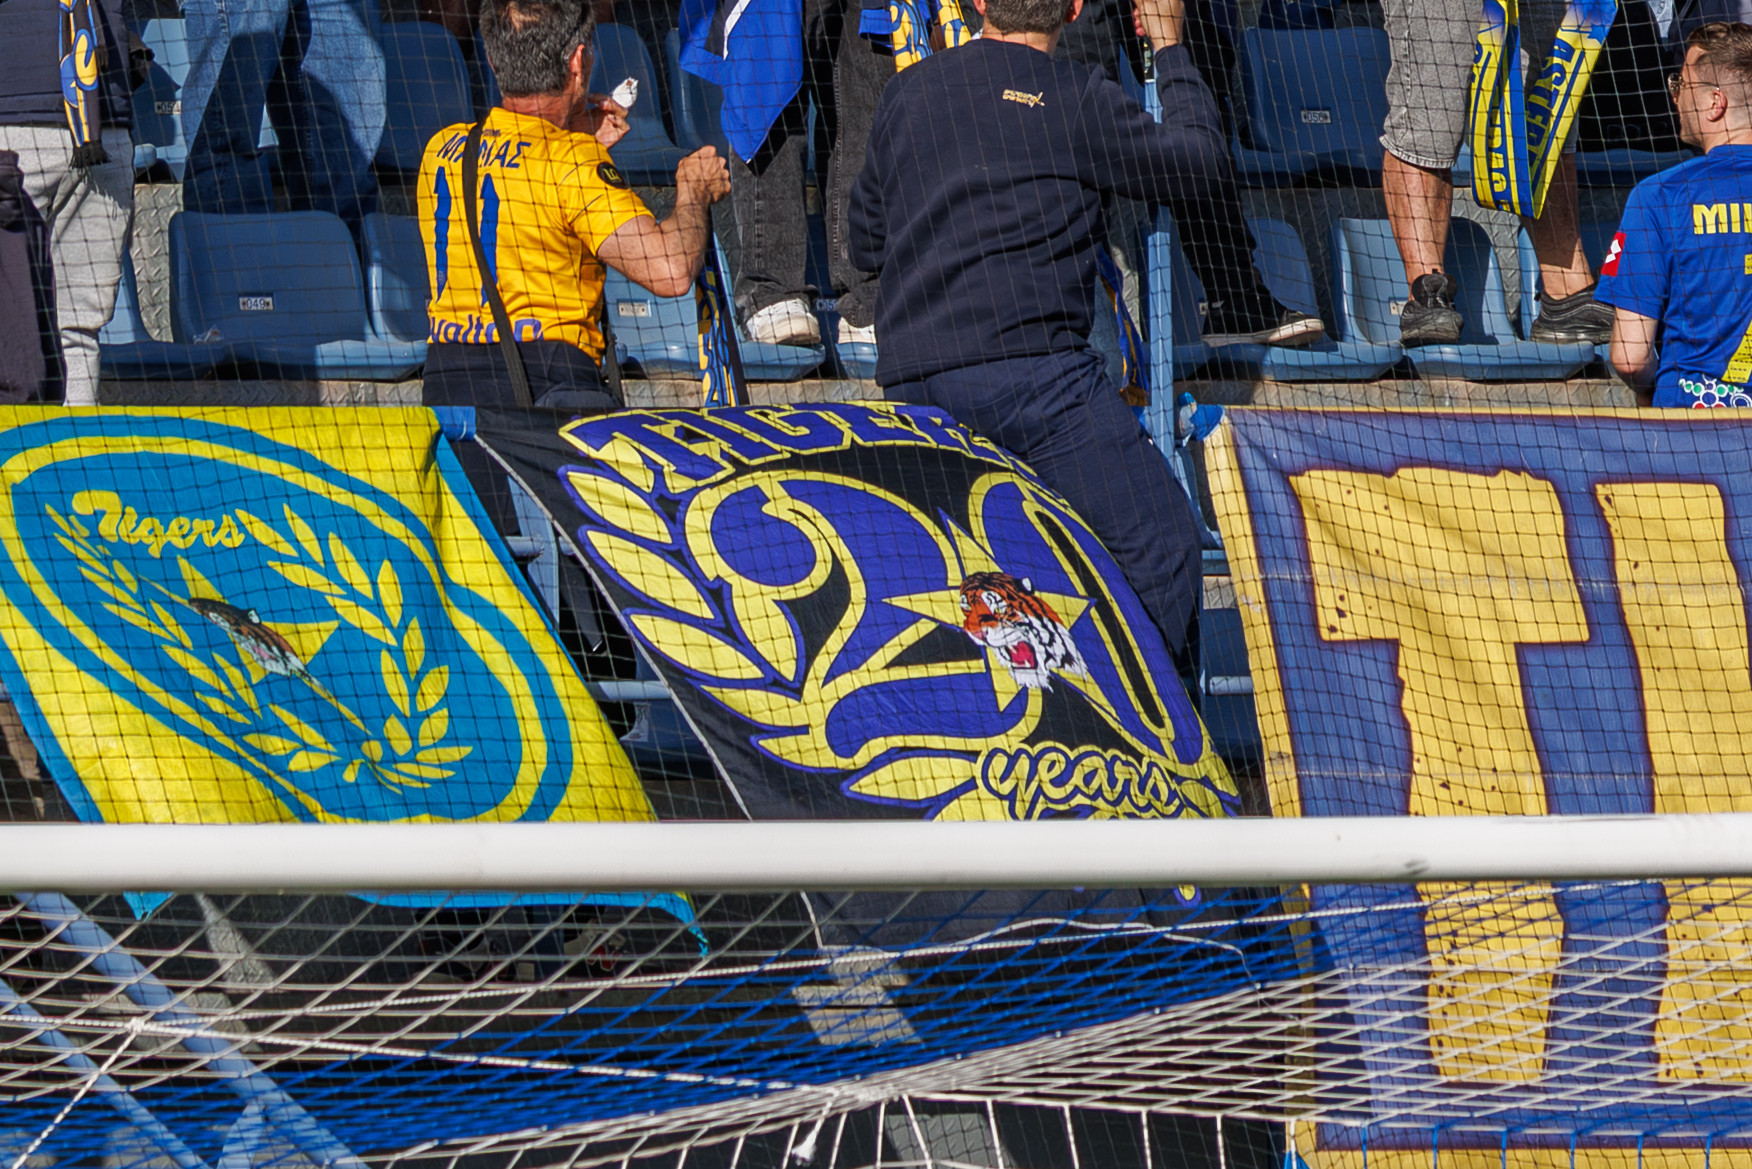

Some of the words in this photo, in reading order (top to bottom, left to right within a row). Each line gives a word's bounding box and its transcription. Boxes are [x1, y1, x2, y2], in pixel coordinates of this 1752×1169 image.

[433, 165, 501, 308] 11
[72, 489, 252, 559] Tigers
[685, 469, 1204, 764] 20
[976, 744, 1182, 821] years
